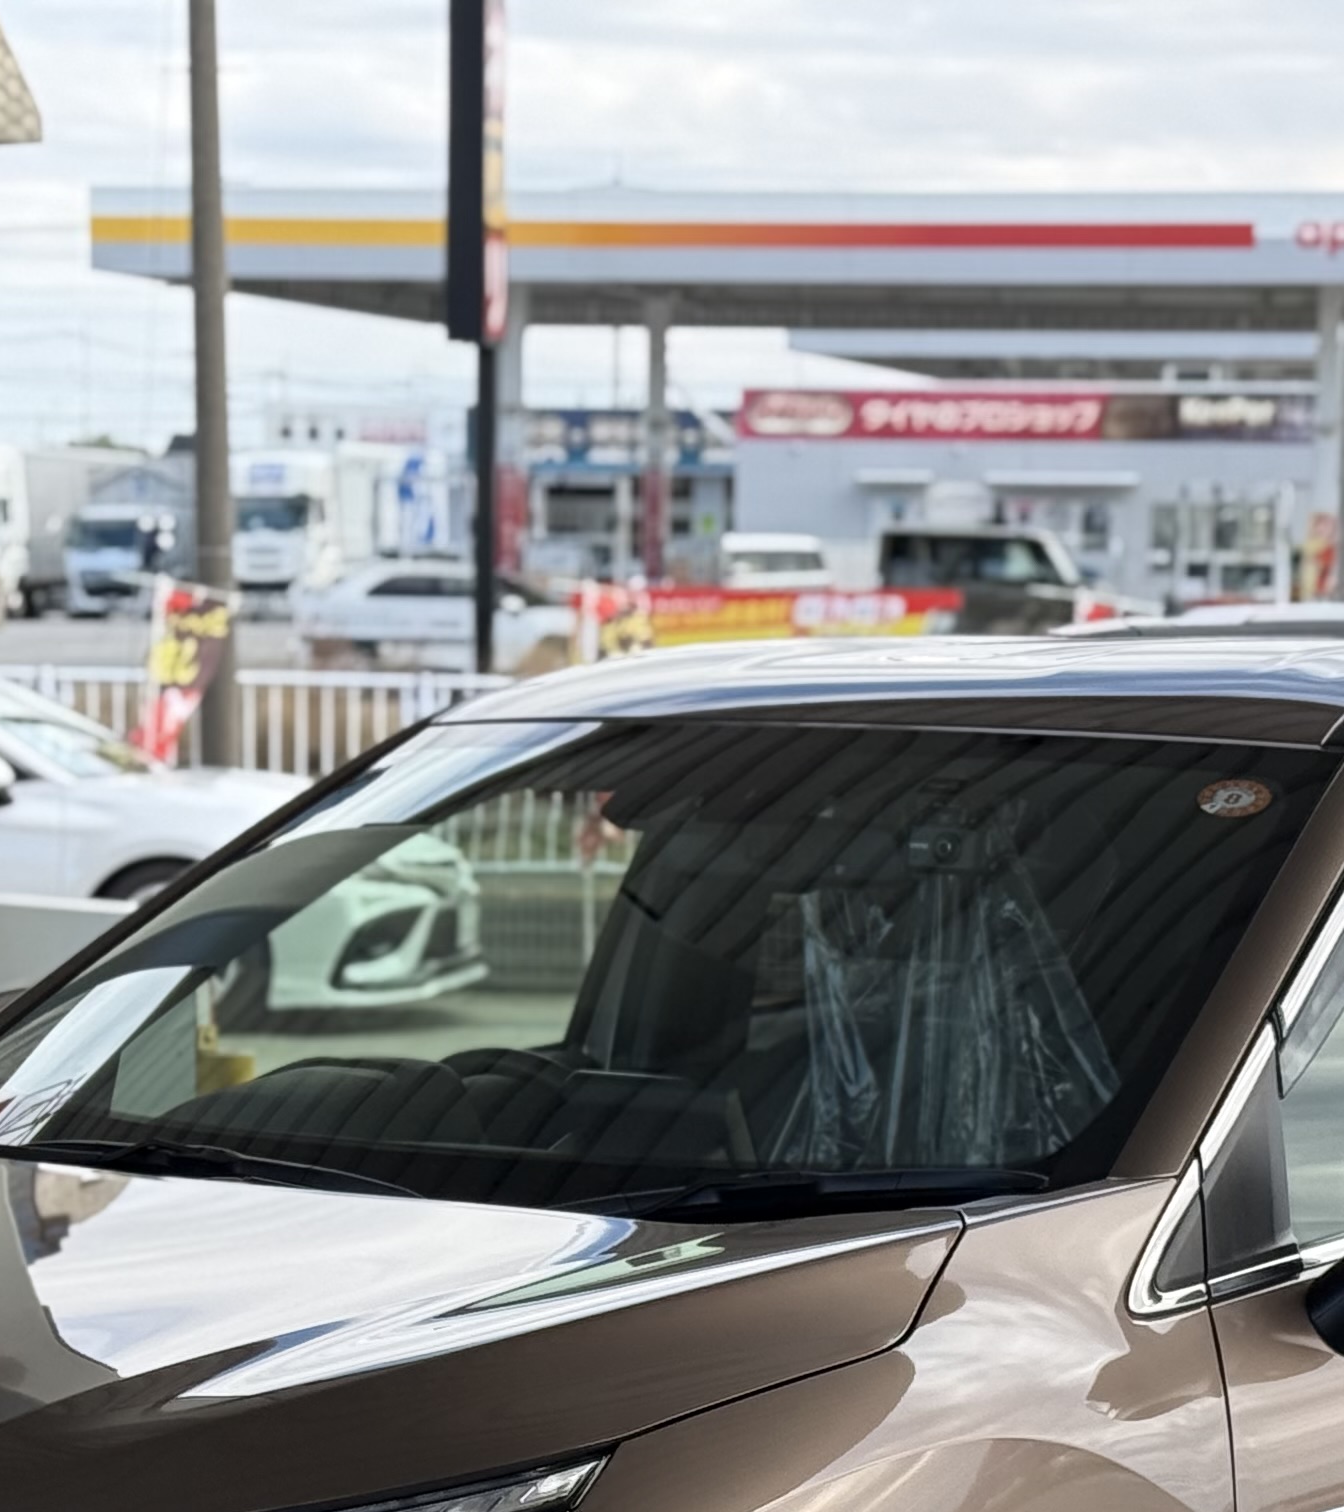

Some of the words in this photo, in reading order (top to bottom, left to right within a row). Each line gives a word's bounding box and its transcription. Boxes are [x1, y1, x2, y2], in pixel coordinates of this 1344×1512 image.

[860, 398, 1102, 434] タイヤのプロショップ
